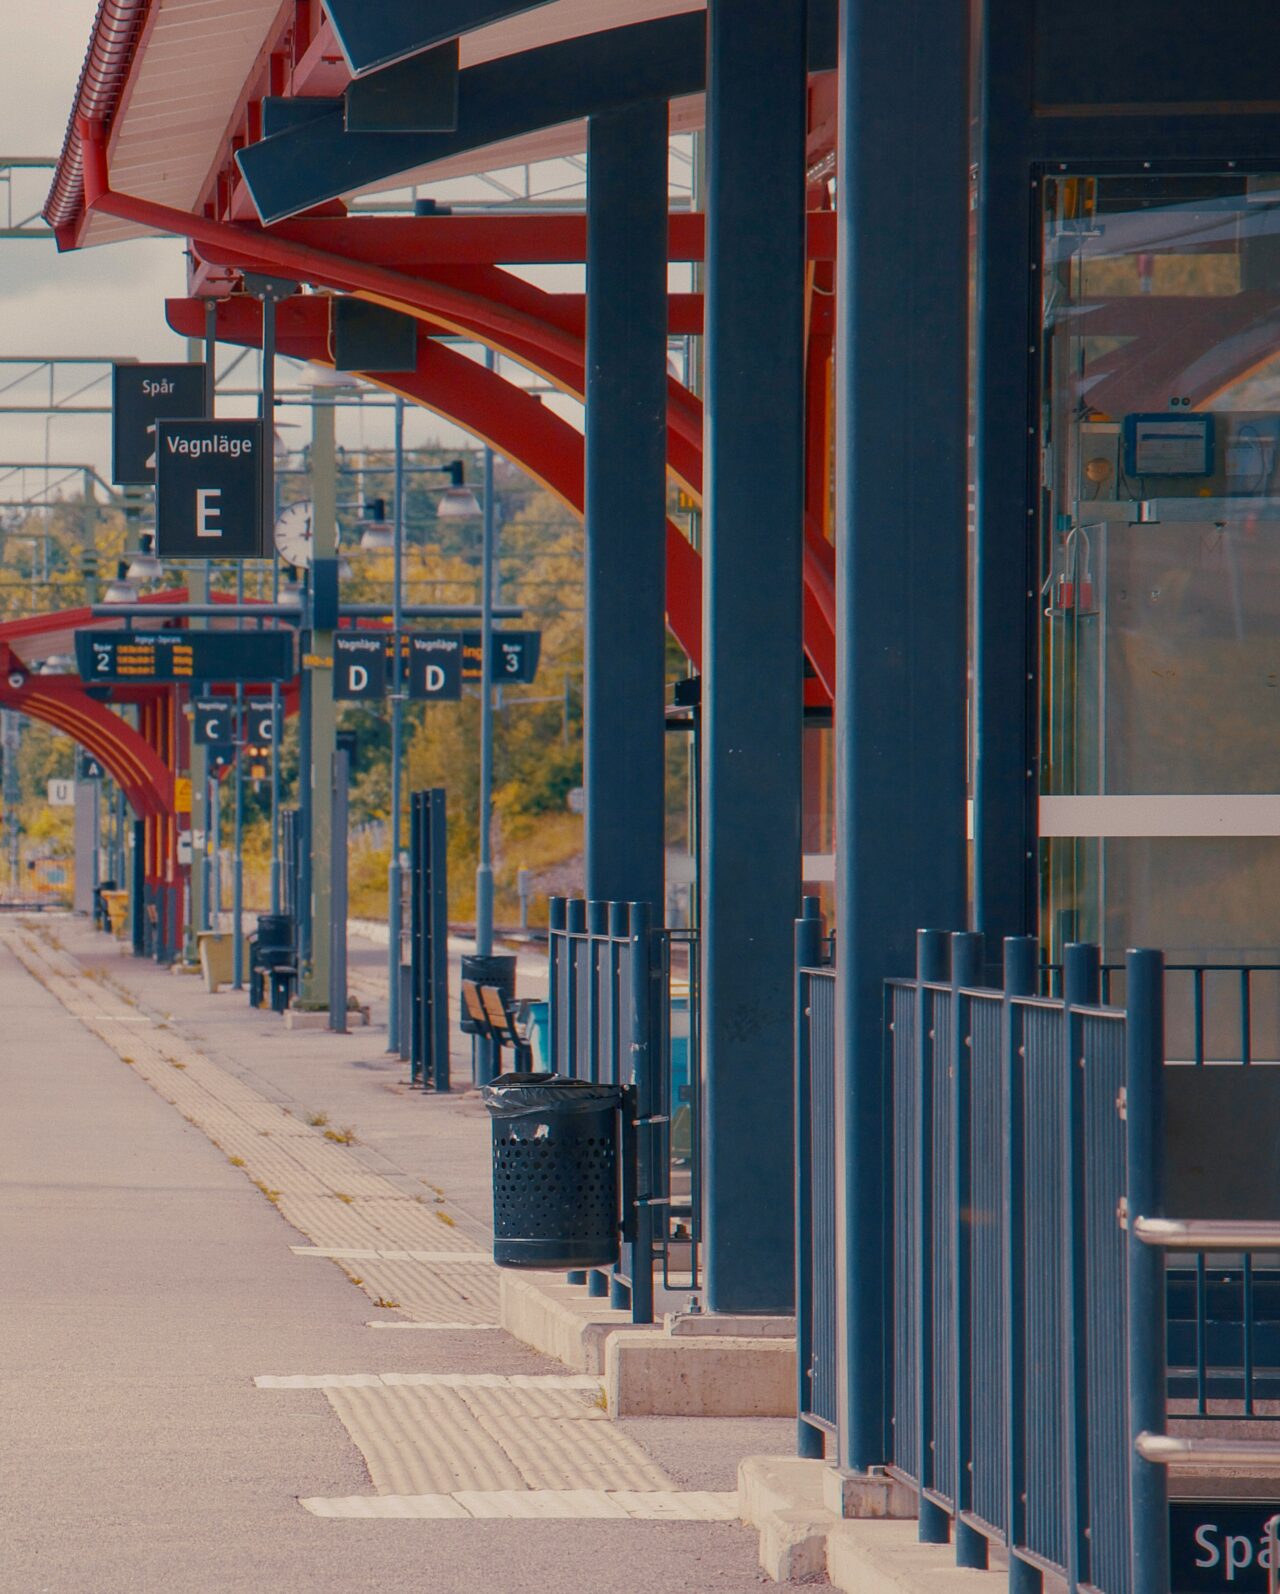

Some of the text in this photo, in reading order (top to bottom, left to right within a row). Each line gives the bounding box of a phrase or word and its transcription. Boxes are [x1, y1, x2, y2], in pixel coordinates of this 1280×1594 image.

[142, 379, 174, 396] Spår
[167, 435, 252, 457] Vagnläge
[196, 488, 222, 537] E
[97, 653, 109, 671] 2
[506, 654, 519, 672] 3
[349, 665, 368, 691] D
[425, 665, 445, 691] D
[205, 719, 219, 739] C
[259, 719, 272, 739] C
[88, 762, 99, 776] A
[56, 785, 67, 800] U
